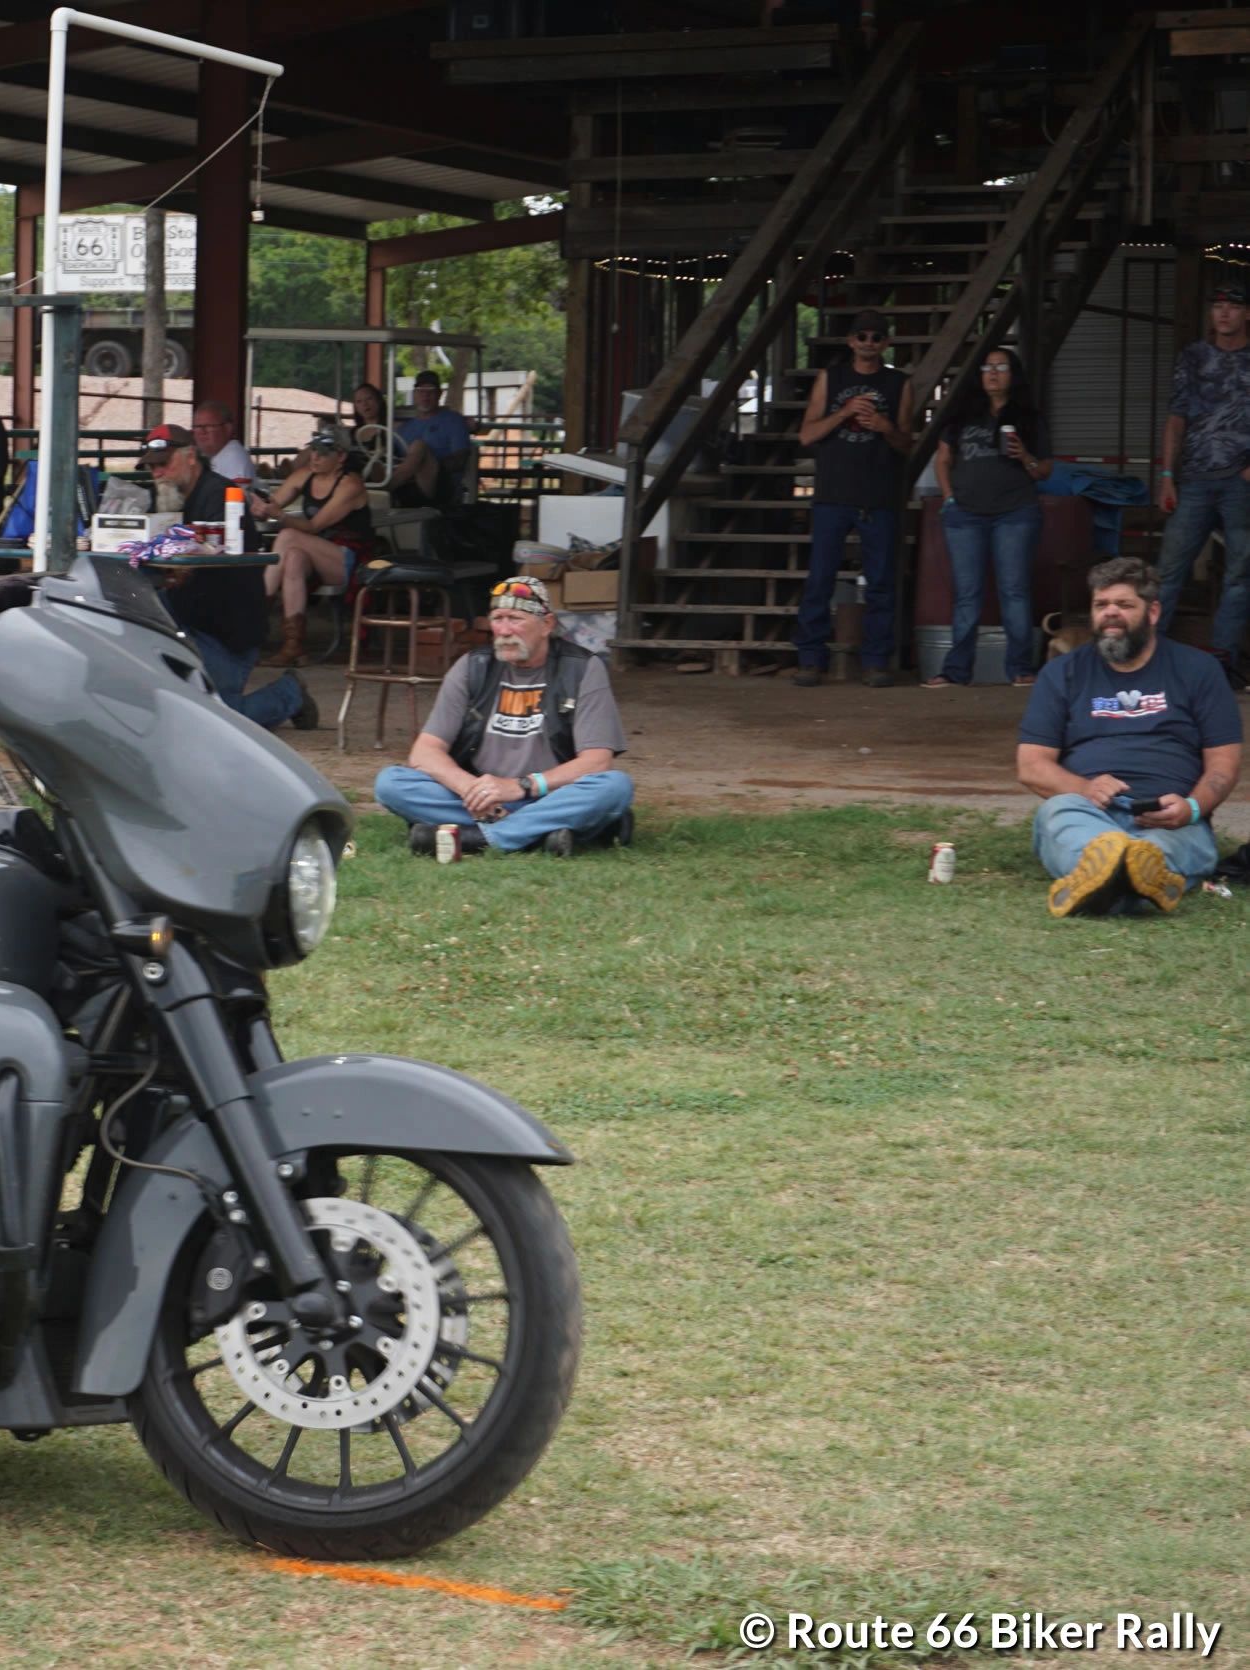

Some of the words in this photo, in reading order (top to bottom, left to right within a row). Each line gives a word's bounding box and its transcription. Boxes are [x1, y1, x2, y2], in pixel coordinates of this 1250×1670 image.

[77, 236, 103, 257] 66
[80, 276, 125, 288] Support
[498, 688, 542, 714] NOPE
